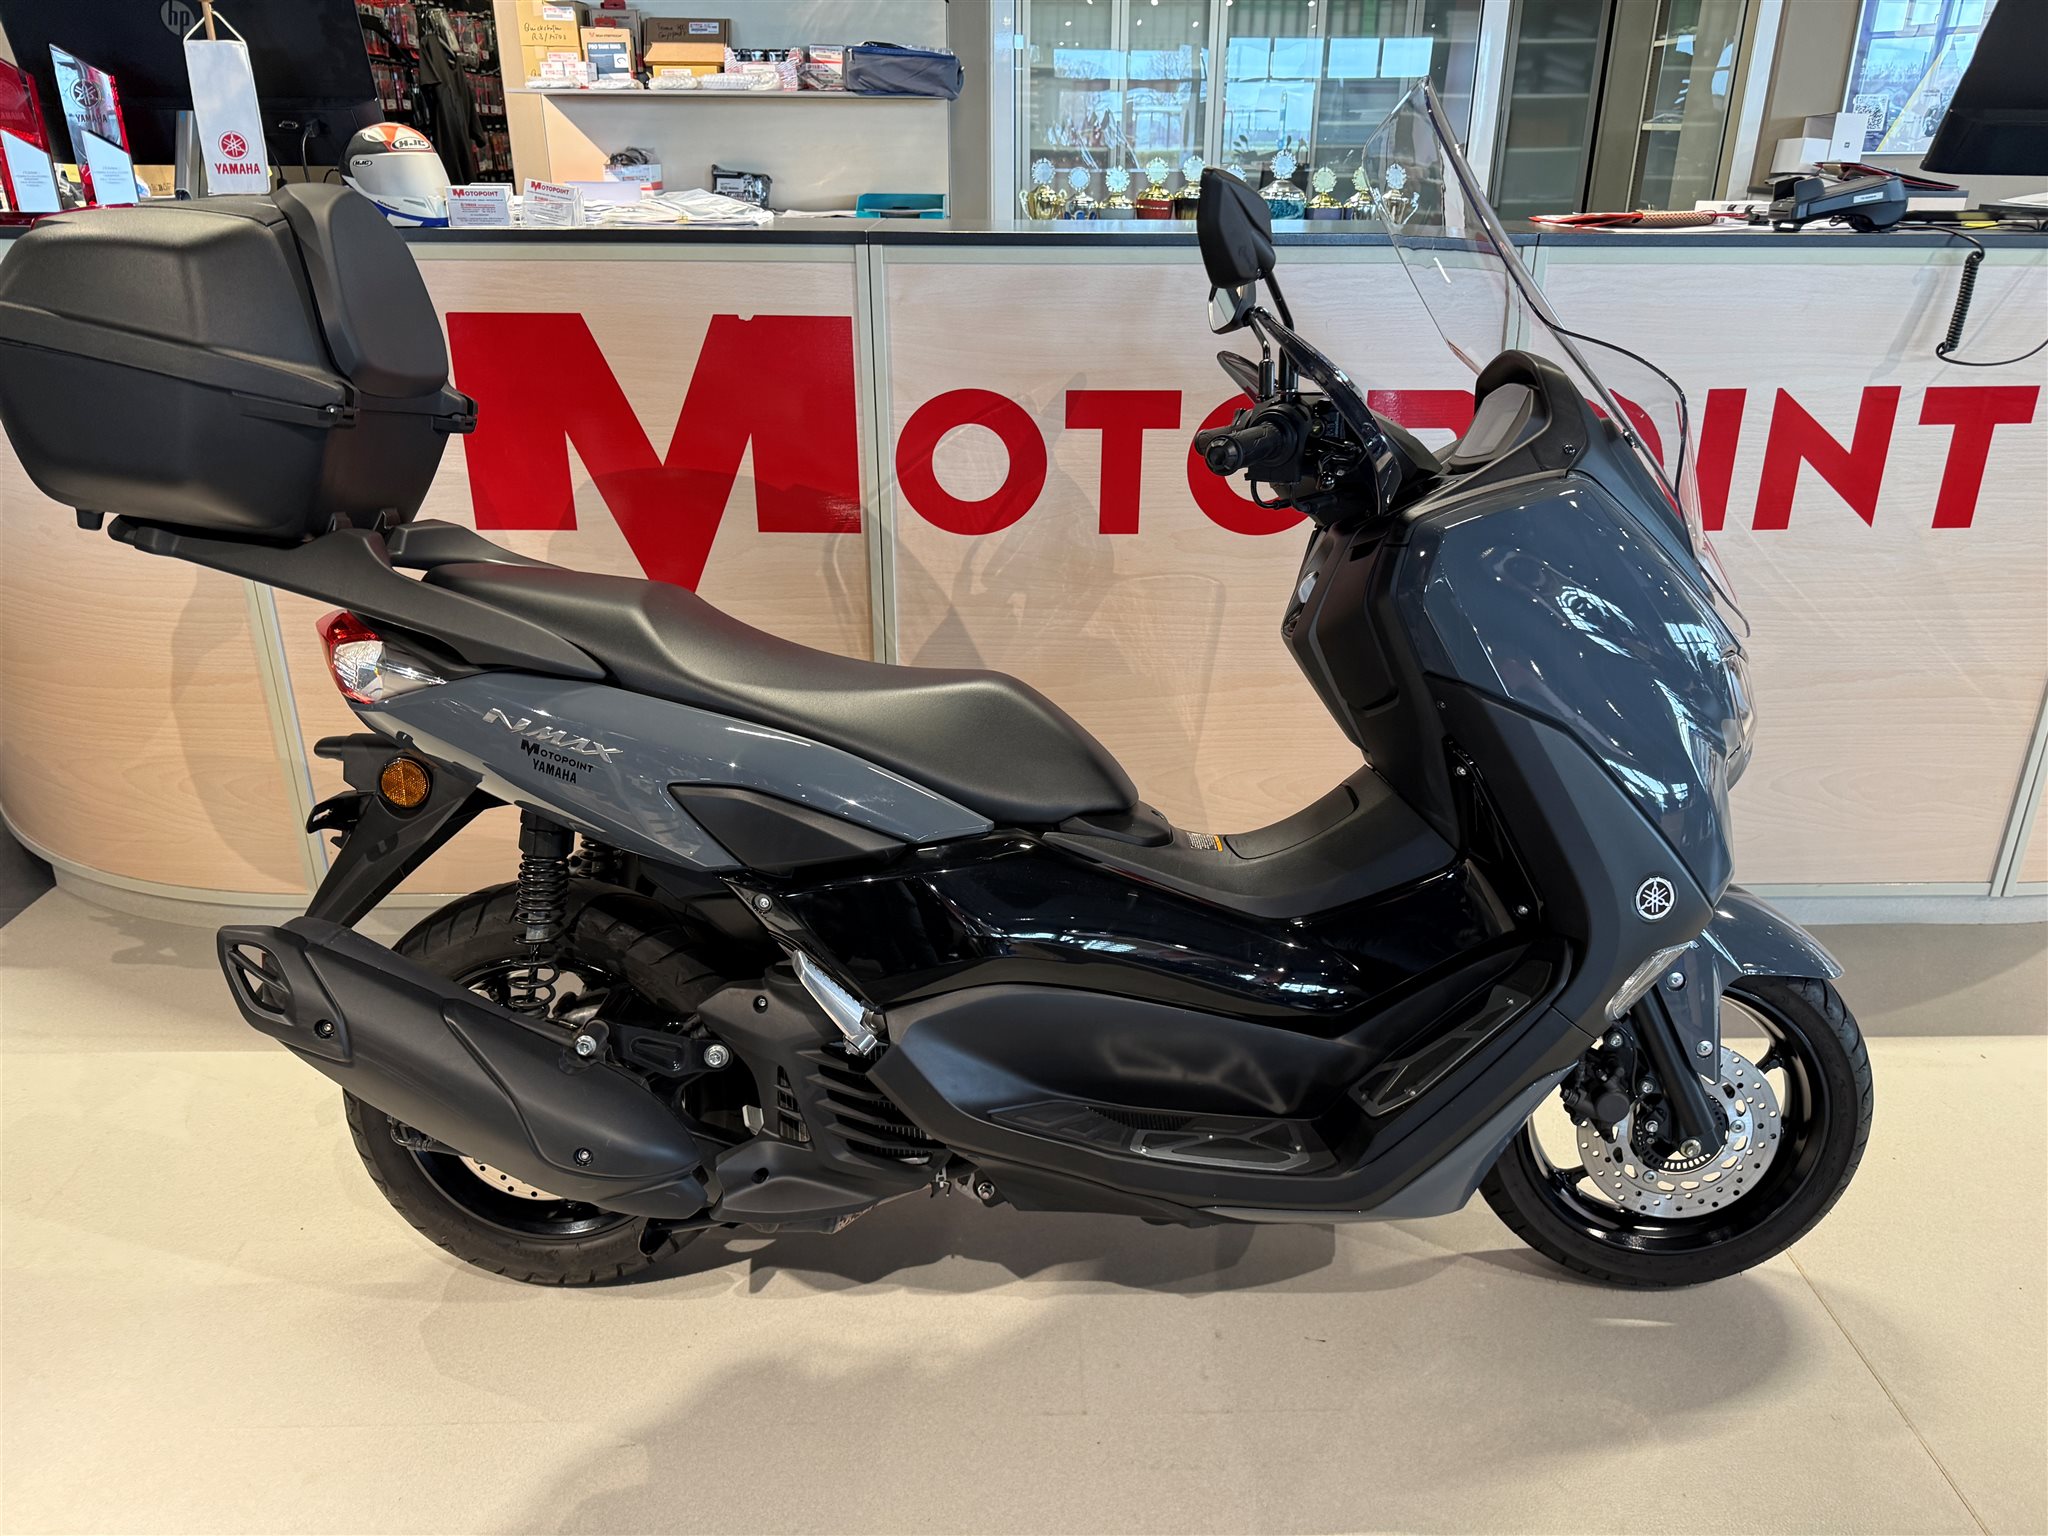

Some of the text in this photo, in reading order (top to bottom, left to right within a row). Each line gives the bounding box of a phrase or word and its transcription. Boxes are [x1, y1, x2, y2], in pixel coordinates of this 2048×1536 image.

[75, 113, 109, 123] YAMAHA
[398, 139, 426, 148] HJC
[214, 162, 261, 175] YAMAHA
[452, 188, 498, 198] MOTOPOINT
[530, 180, 570, 195] MOTOPOINT
[446, 312, 2040, 592] MOTOINT
[482, 707, 624, 764] NMAX
[520, 739, 594, 773] MOTOPOINT
[532, 758, 577, 785] YAMAHA
